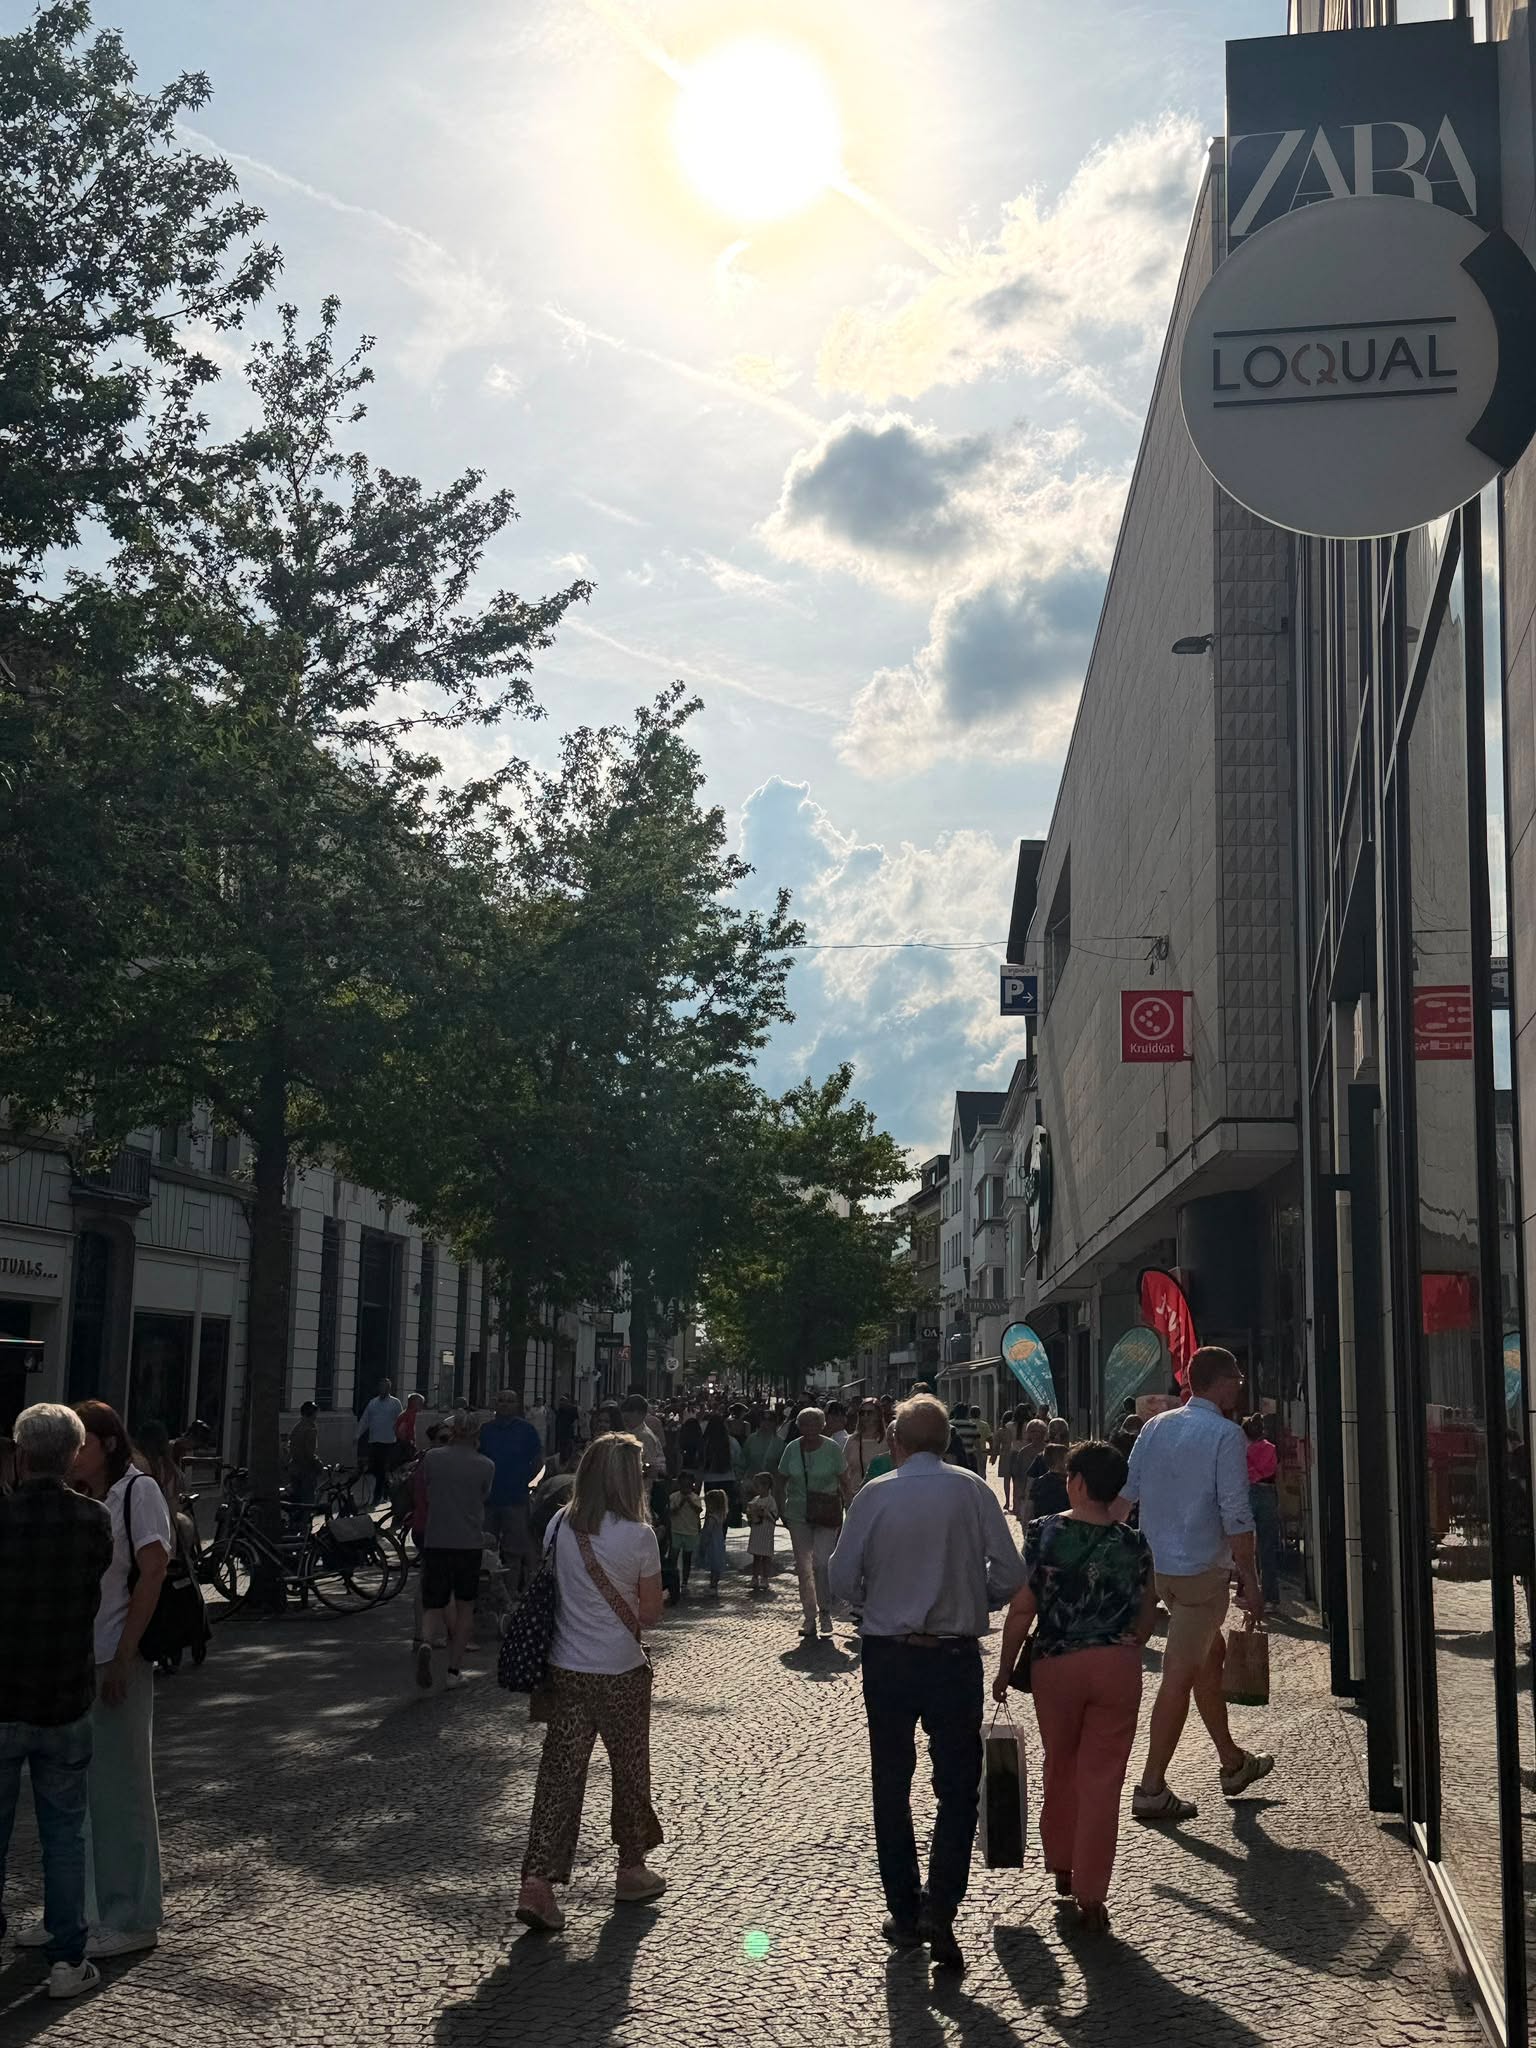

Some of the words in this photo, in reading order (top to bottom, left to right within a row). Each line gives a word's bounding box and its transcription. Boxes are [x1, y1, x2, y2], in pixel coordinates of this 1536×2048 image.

[1231, 113, 1478, 237] ZARA
[1213, 334, 1458, 391] LOQUAL
[1004, 979, 1024, 1004] P
[1130, 1043, 1175, 1054] Kruidvat
